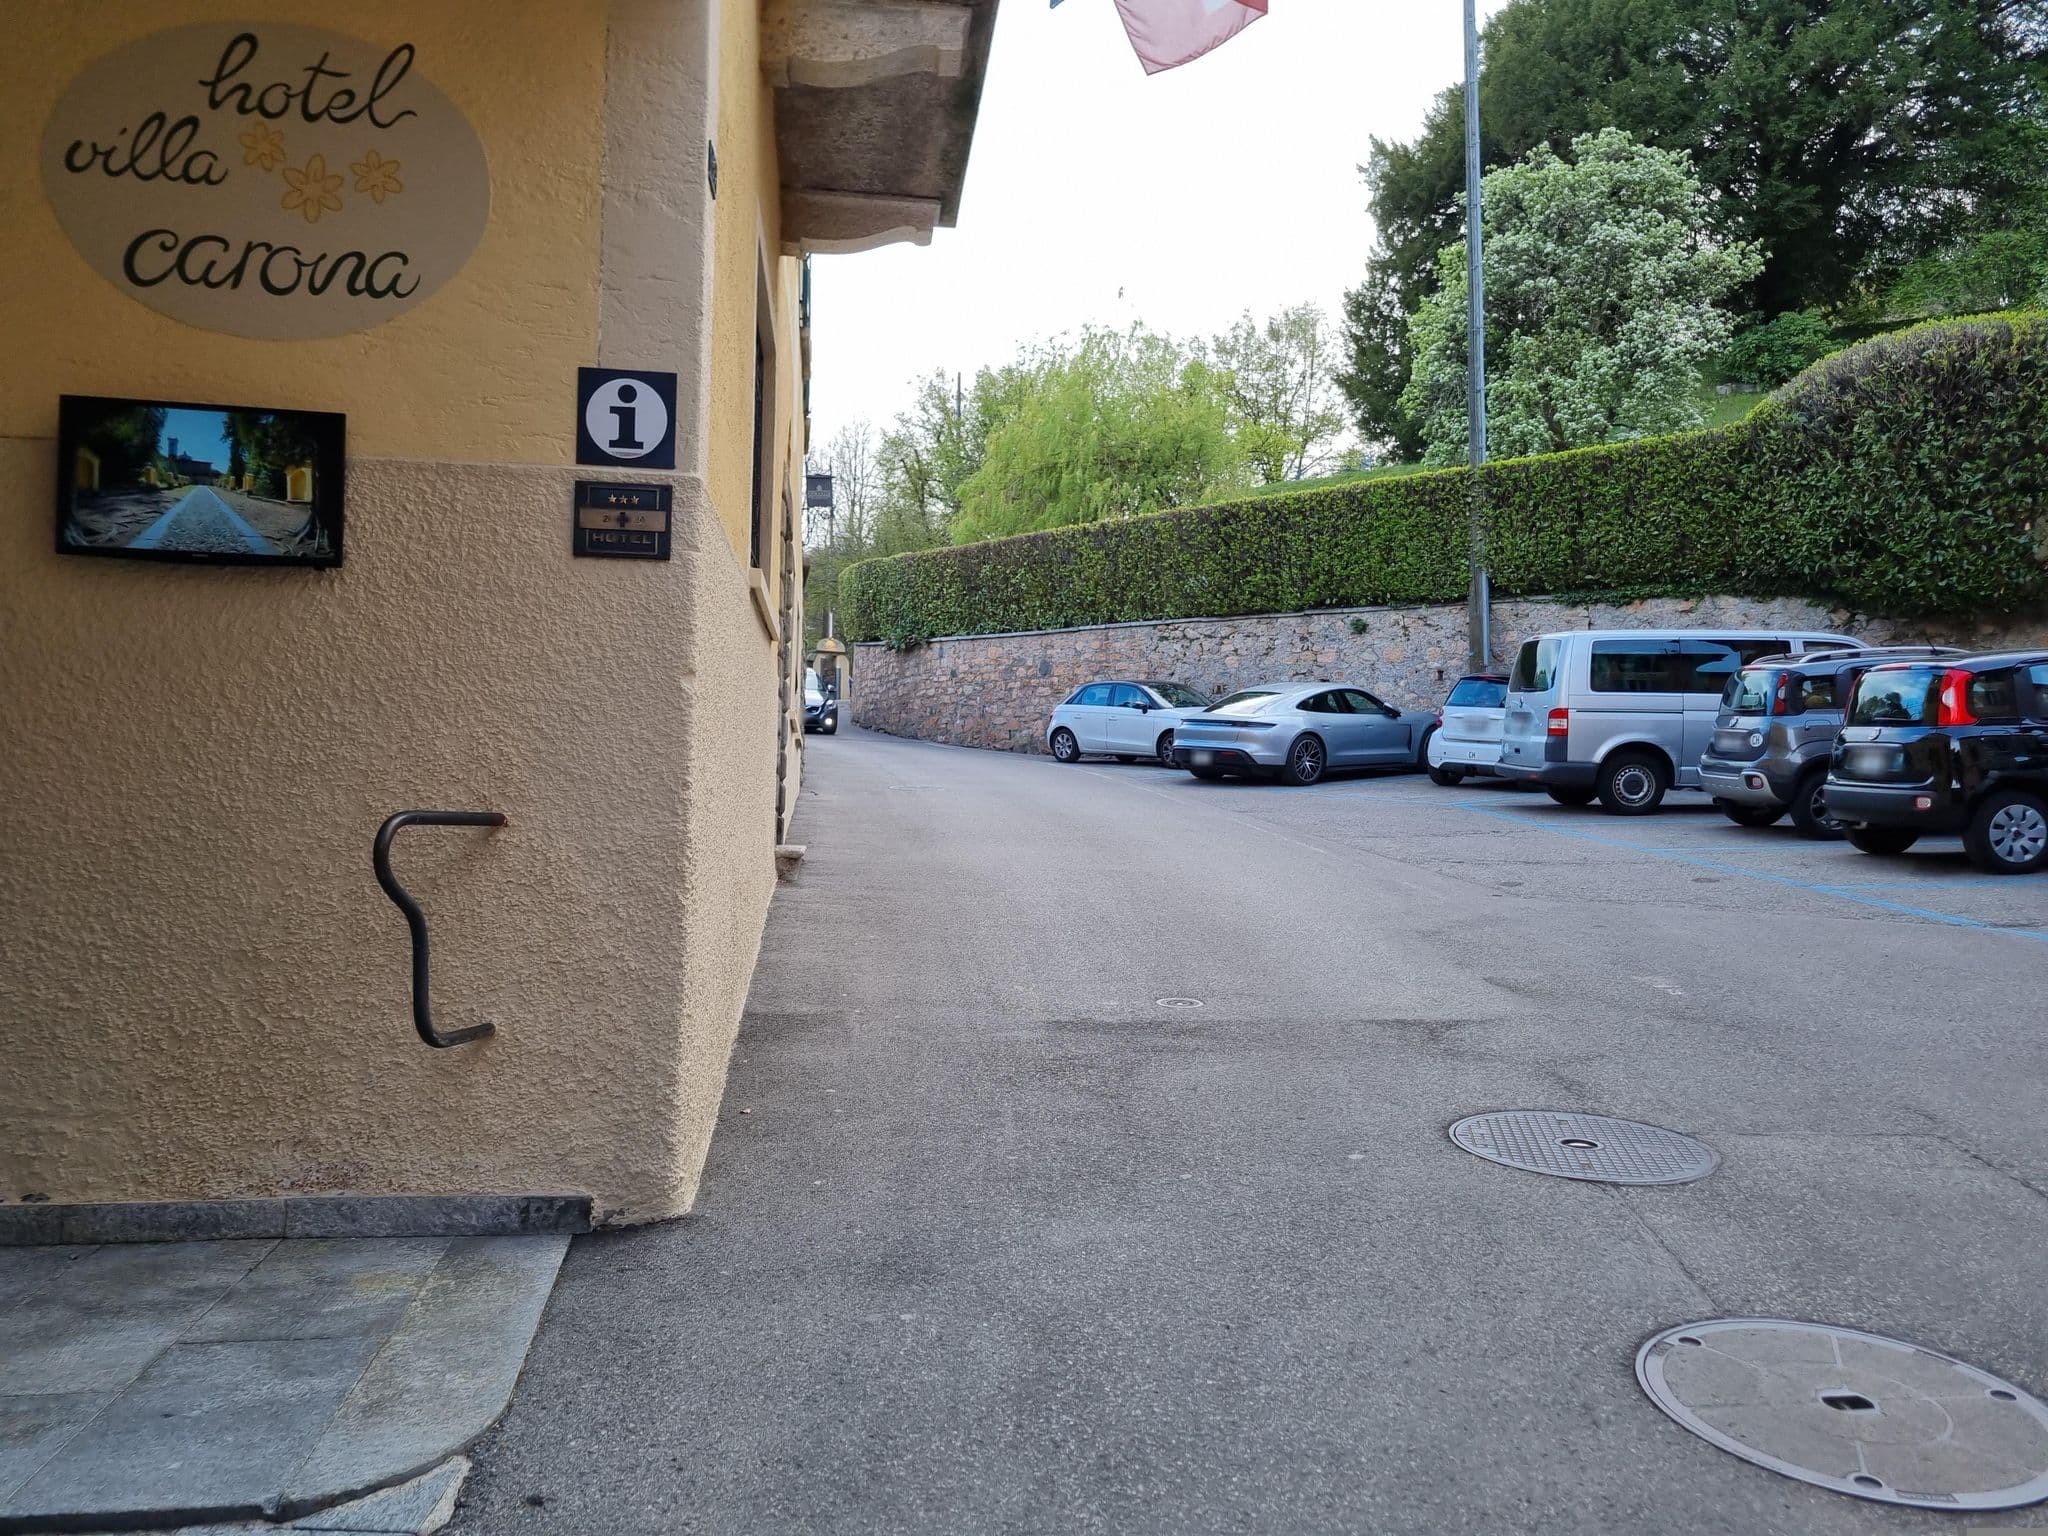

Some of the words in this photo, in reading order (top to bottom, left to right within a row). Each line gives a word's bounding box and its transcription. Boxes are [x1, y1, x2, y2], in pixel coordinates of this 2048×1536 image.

[199, 32, 418, 129] hotel
[64, 111, 228, 186] villa
[123, 229, 421, 299] carona
